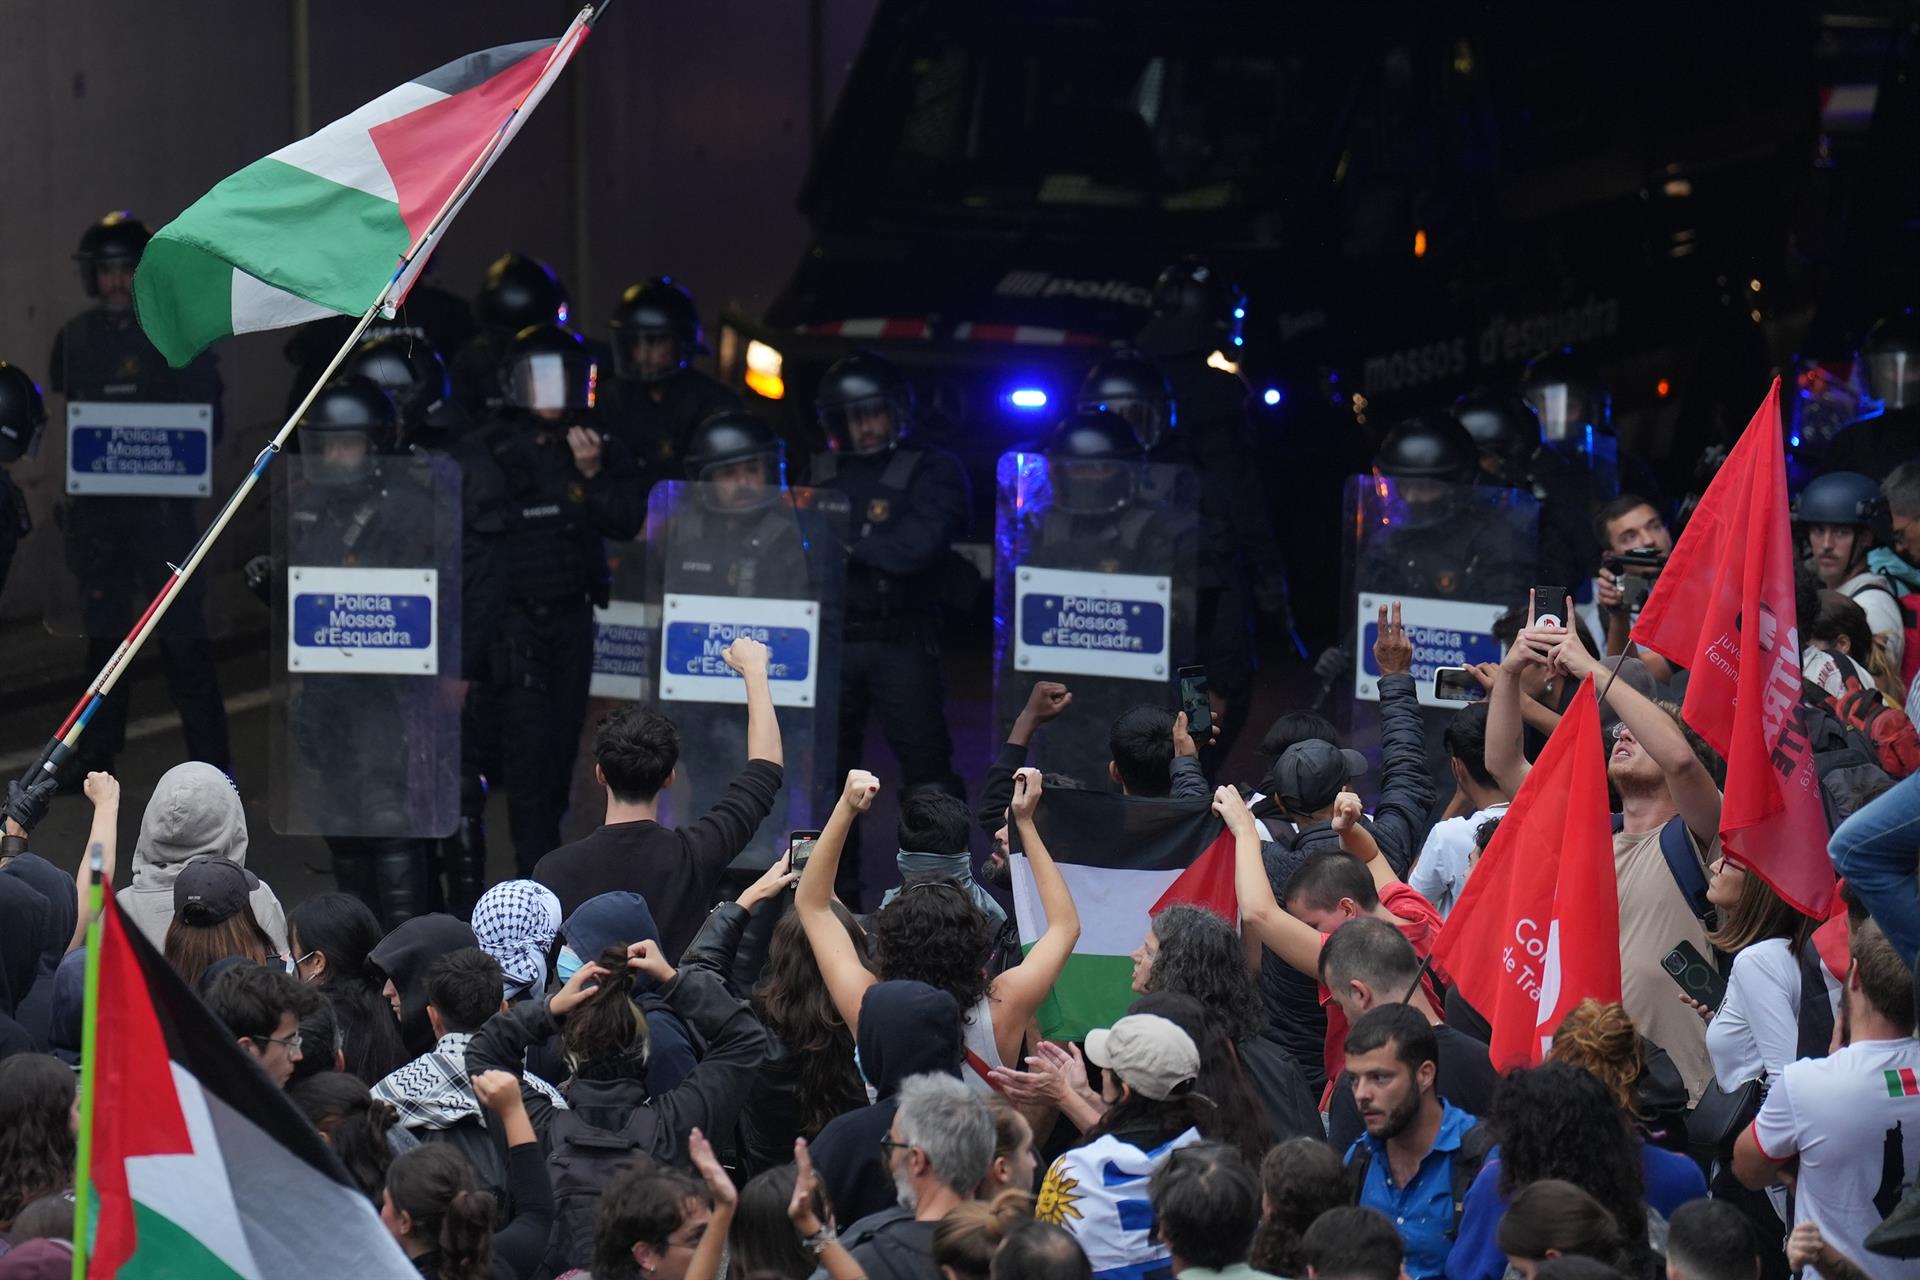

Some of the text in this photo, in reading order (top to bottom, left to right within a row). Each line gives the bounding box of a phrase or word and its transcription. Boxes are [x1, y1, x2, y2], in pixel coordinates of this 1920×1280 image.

[1363, 294, 1618, 392] mossos d'esquadra
[106, 441, 173, 459] Mossos
[329, 610, 397, 628] Mossos
[1058, 611, 1129, 632] Mossos
[314, 627, 411, 648] d'Esquadra
[1041, 627, 1143, 650] d'Esquadra
[1412, 642, 1467, 665] ossos
